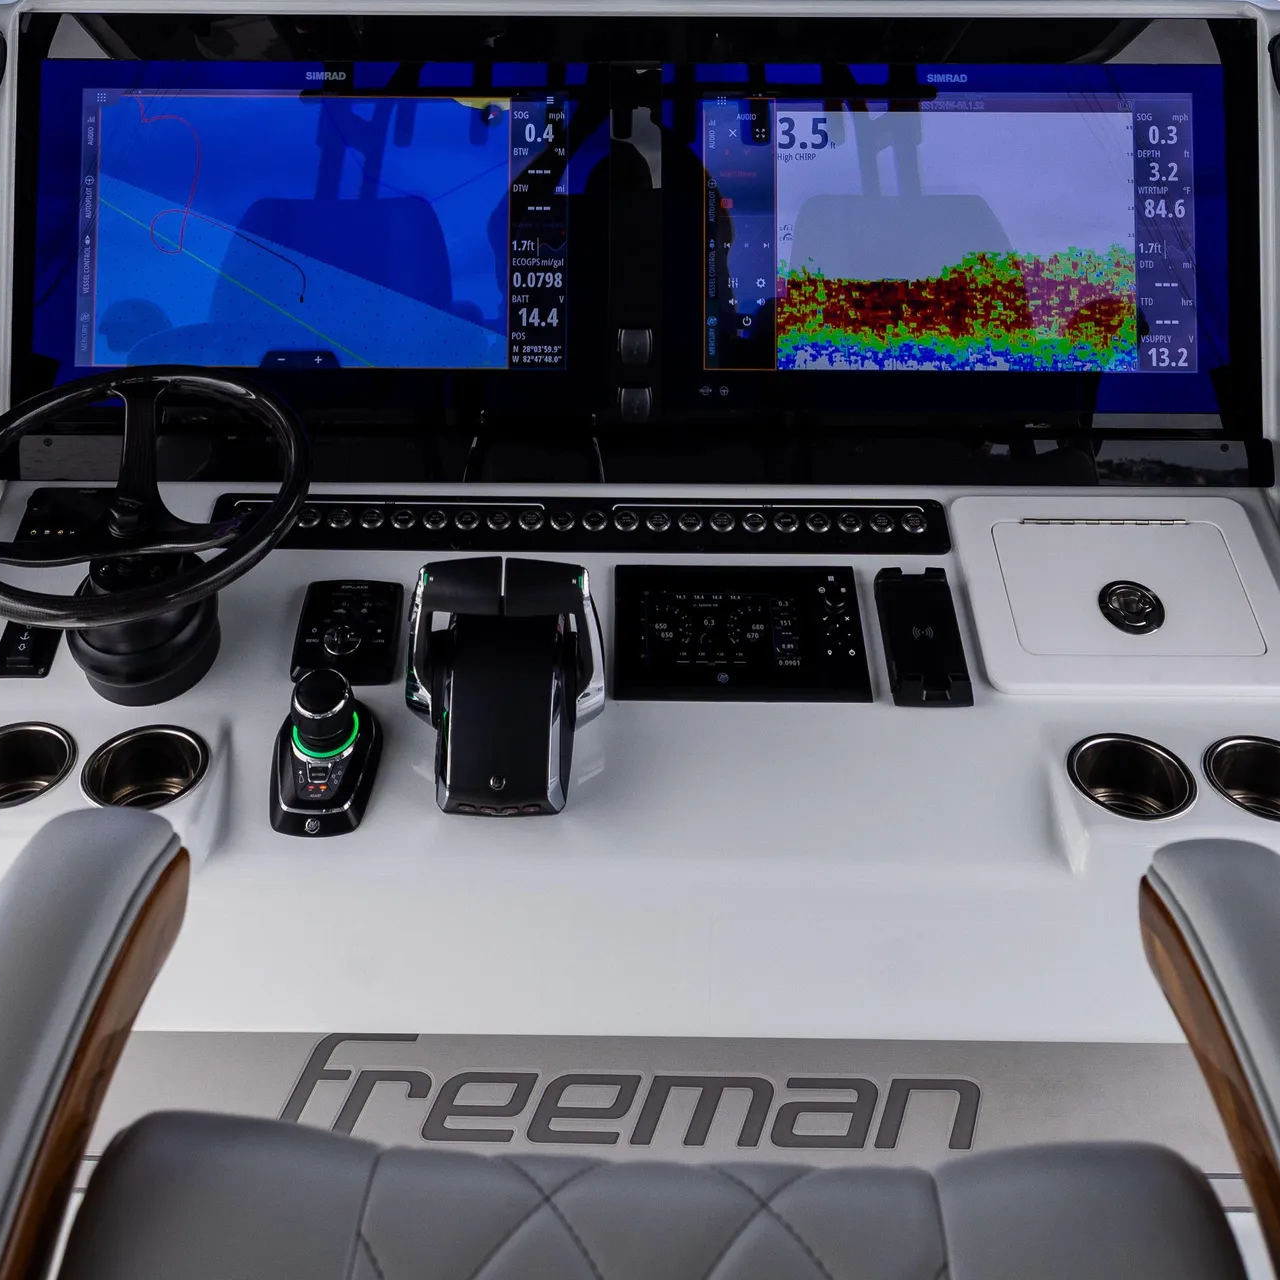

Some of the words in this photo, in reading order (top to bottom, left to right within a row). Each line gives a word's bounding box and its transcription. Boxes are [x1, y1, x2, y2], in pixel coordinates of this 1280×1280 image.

[305, 71, 347, 81] SIMRAD
[926, 74, 968, 83] SIMRAD
[513, 111, 530, 120] SOG
[548, 111, 566, 122] mph
[736, 113, 758, 121] AUDIO
[1136, 113, 1153, 121] SOG
[1172, 113, 1189, 123] mph
[87, 126, 95, 146] AUDIO
[524, 123, 555, 143] 0.4
[778, 116, 829, 150] 3.5
[1148, 125, 1179, 145] 0.3
[708, 129, 716, 149] AUDIO
[513, 147, 530, 156] BTW
[1137, 150, 1162, 158] DEPTH
[1184, 150, 1191, 158] ft
[777, 153, 793, 163] High
[794, 153, 817, 161] CHIRP
[1149, 162, 1180, 182] 3.2
[513, 183, 529, 193] DTW
[555, 184, 565, 193] mi
[1137, 186, 1169, 195] WTRTMP
[84, 188, 93, 219] AUTOPILOT
[1144, 199, 1187, 218] 84.6
[511, 240, 535, 251] 1.7ft
[1138, 243, 1162, 254] 1.7ft
[83, 246, 91, 273] CONTROL
[512, 257, 540, 266] ECOGPS
[540, 258, 565, 269] mi/gal
[1139, 260, 1154, 269] DTD
[1182, 261, 1192, 269] mi
[82, 274, 90, 294] VESSEL
[512, 272, 564, 288] 0.0798
[511, 294, 530, 304] BATT
[558, 295, 565, 304] V
[1140, 297, 1154, 306] TTD
[1181, 297, 1193, 306] hrs
[518, 307, 559, 327] 14.4
[80, 324, 88, 352] MERCURY
[511, 331, 527, 341] POS
[1140, 334, 1172, 343] VSUPPLY
[1188, 334, 1195, 343] V
[512, 345, 520, 353] N
[511, 355, 520, 363] W
[1148, 347, 1189, 367] 13.2
[277, 1032, 983, 1150] freeman
